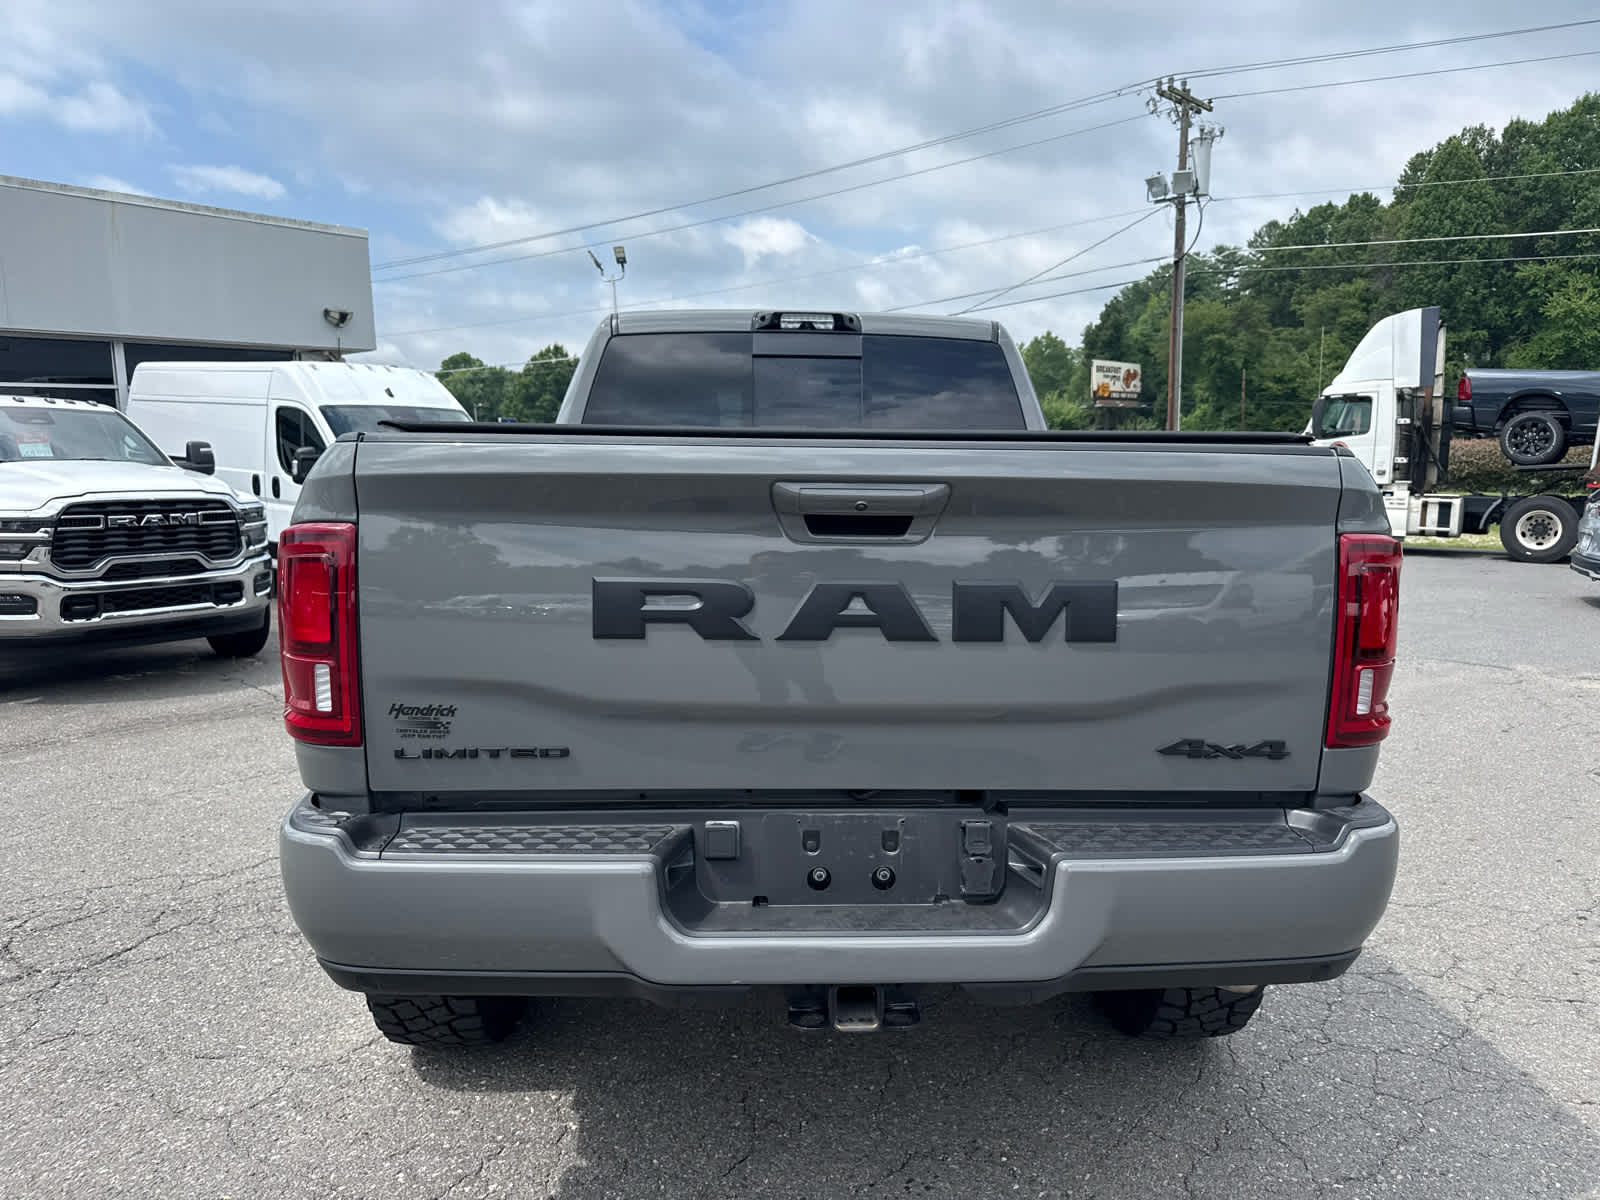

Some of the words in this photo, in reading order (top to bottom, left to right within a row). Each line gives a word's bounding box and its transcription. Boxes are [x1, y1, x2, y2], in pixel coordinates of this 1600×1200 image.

[108, 513, 197, 527] RAM
[592, 577, 1119, 642] RAM
[388, 703, 458, 719] Hendrick
[393, 746, 570, 760] LIMITED
